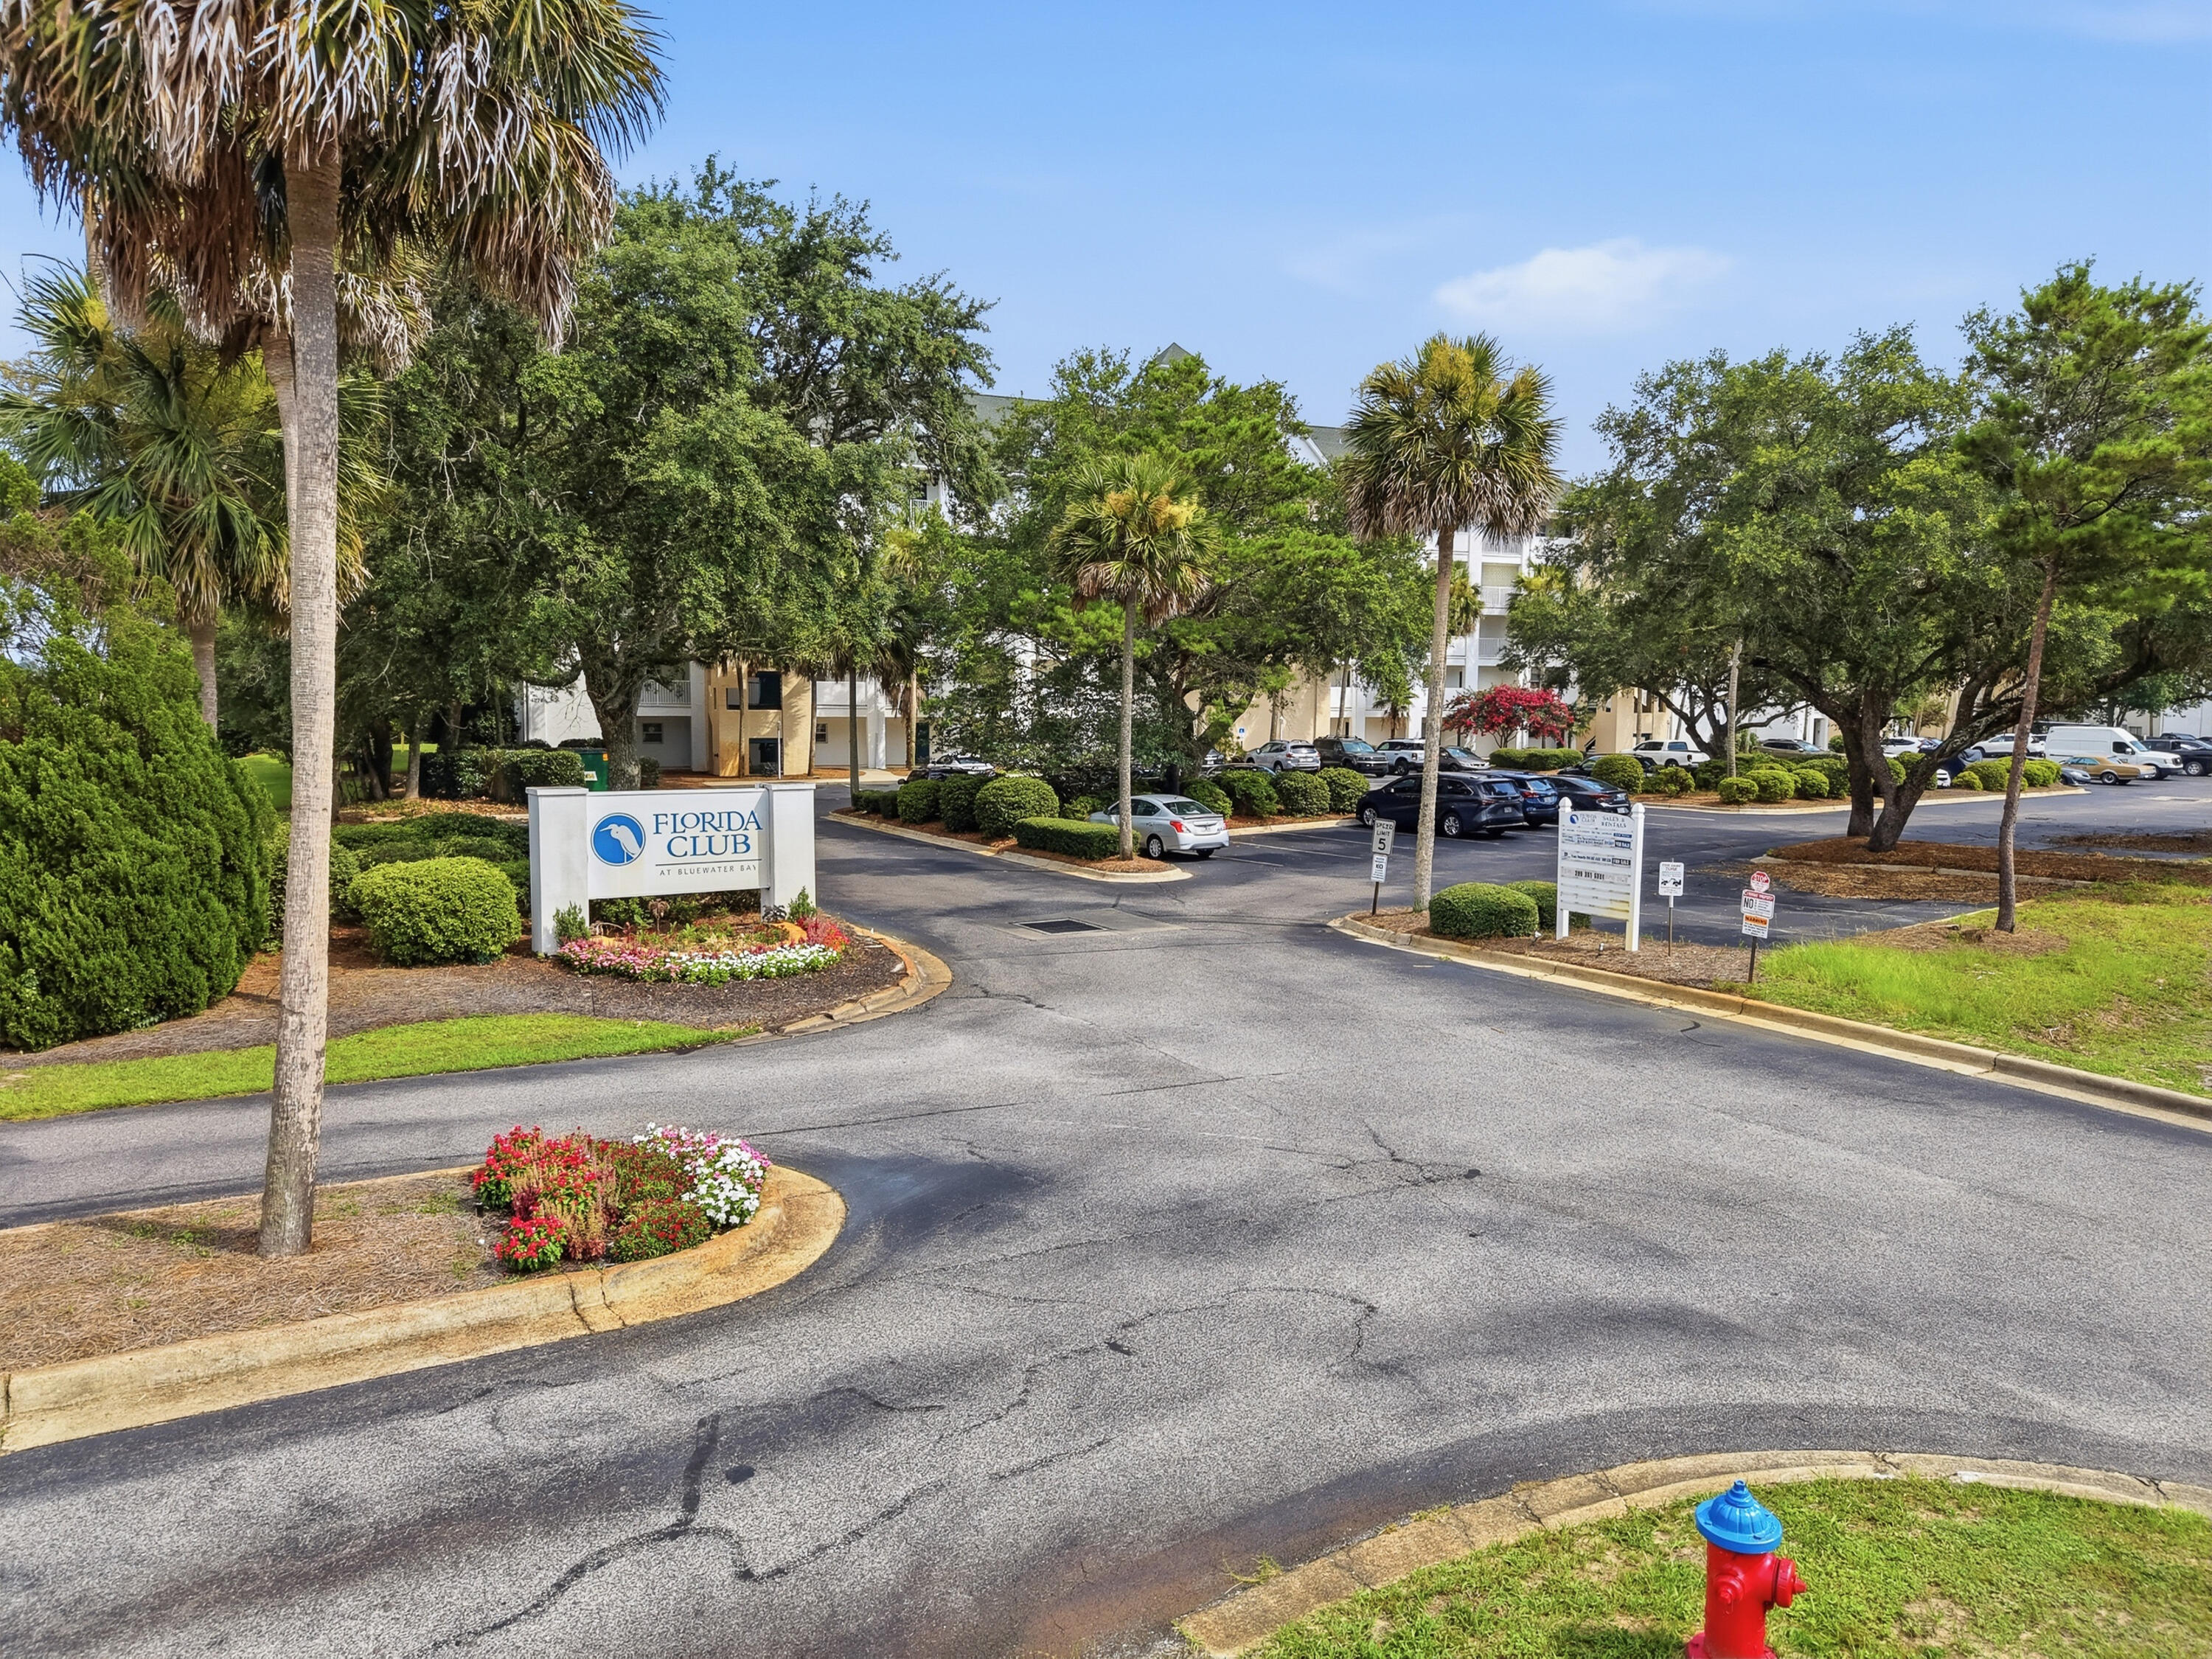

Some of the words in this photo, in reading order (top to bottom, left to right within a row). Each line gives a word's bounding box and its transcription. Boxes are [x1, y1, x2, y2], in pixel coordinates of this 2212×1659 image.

[653, 810, 763, 835] FLORIDA
[667, 833, 751, 858] CLUB
[1378, 838, 1386, 850] 5
[678, 865, 735, 875] BLUEWATER
[740, 864, 757, 872] BAY
[1743, 897, 1754, 909] NO
